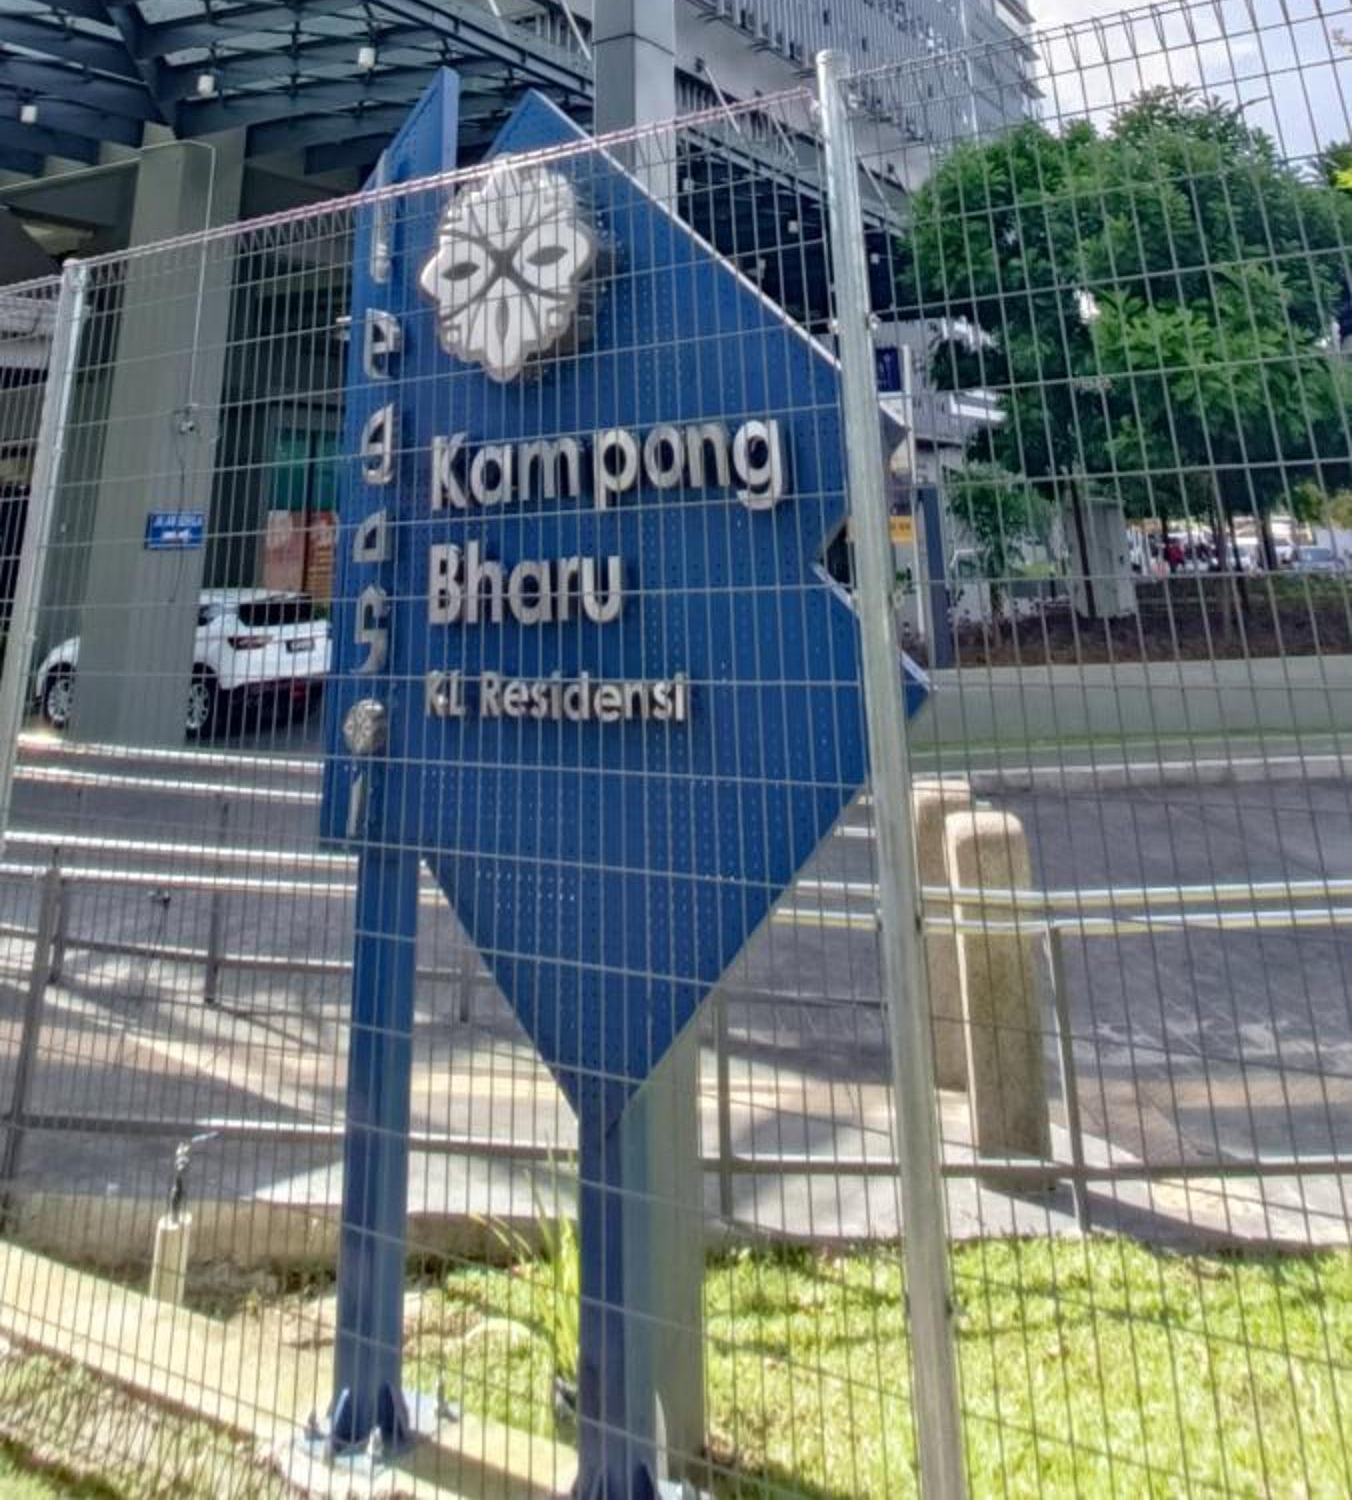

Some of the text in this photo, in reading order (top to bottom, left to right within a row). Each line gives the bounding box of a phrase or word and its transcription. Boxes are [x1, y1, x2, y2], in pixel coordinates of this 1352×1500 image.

[430, 420, 783, 511] Kampong
[428, 540, 622, 626] Bharu
[425, 669, 688, 722] KL Residensi
